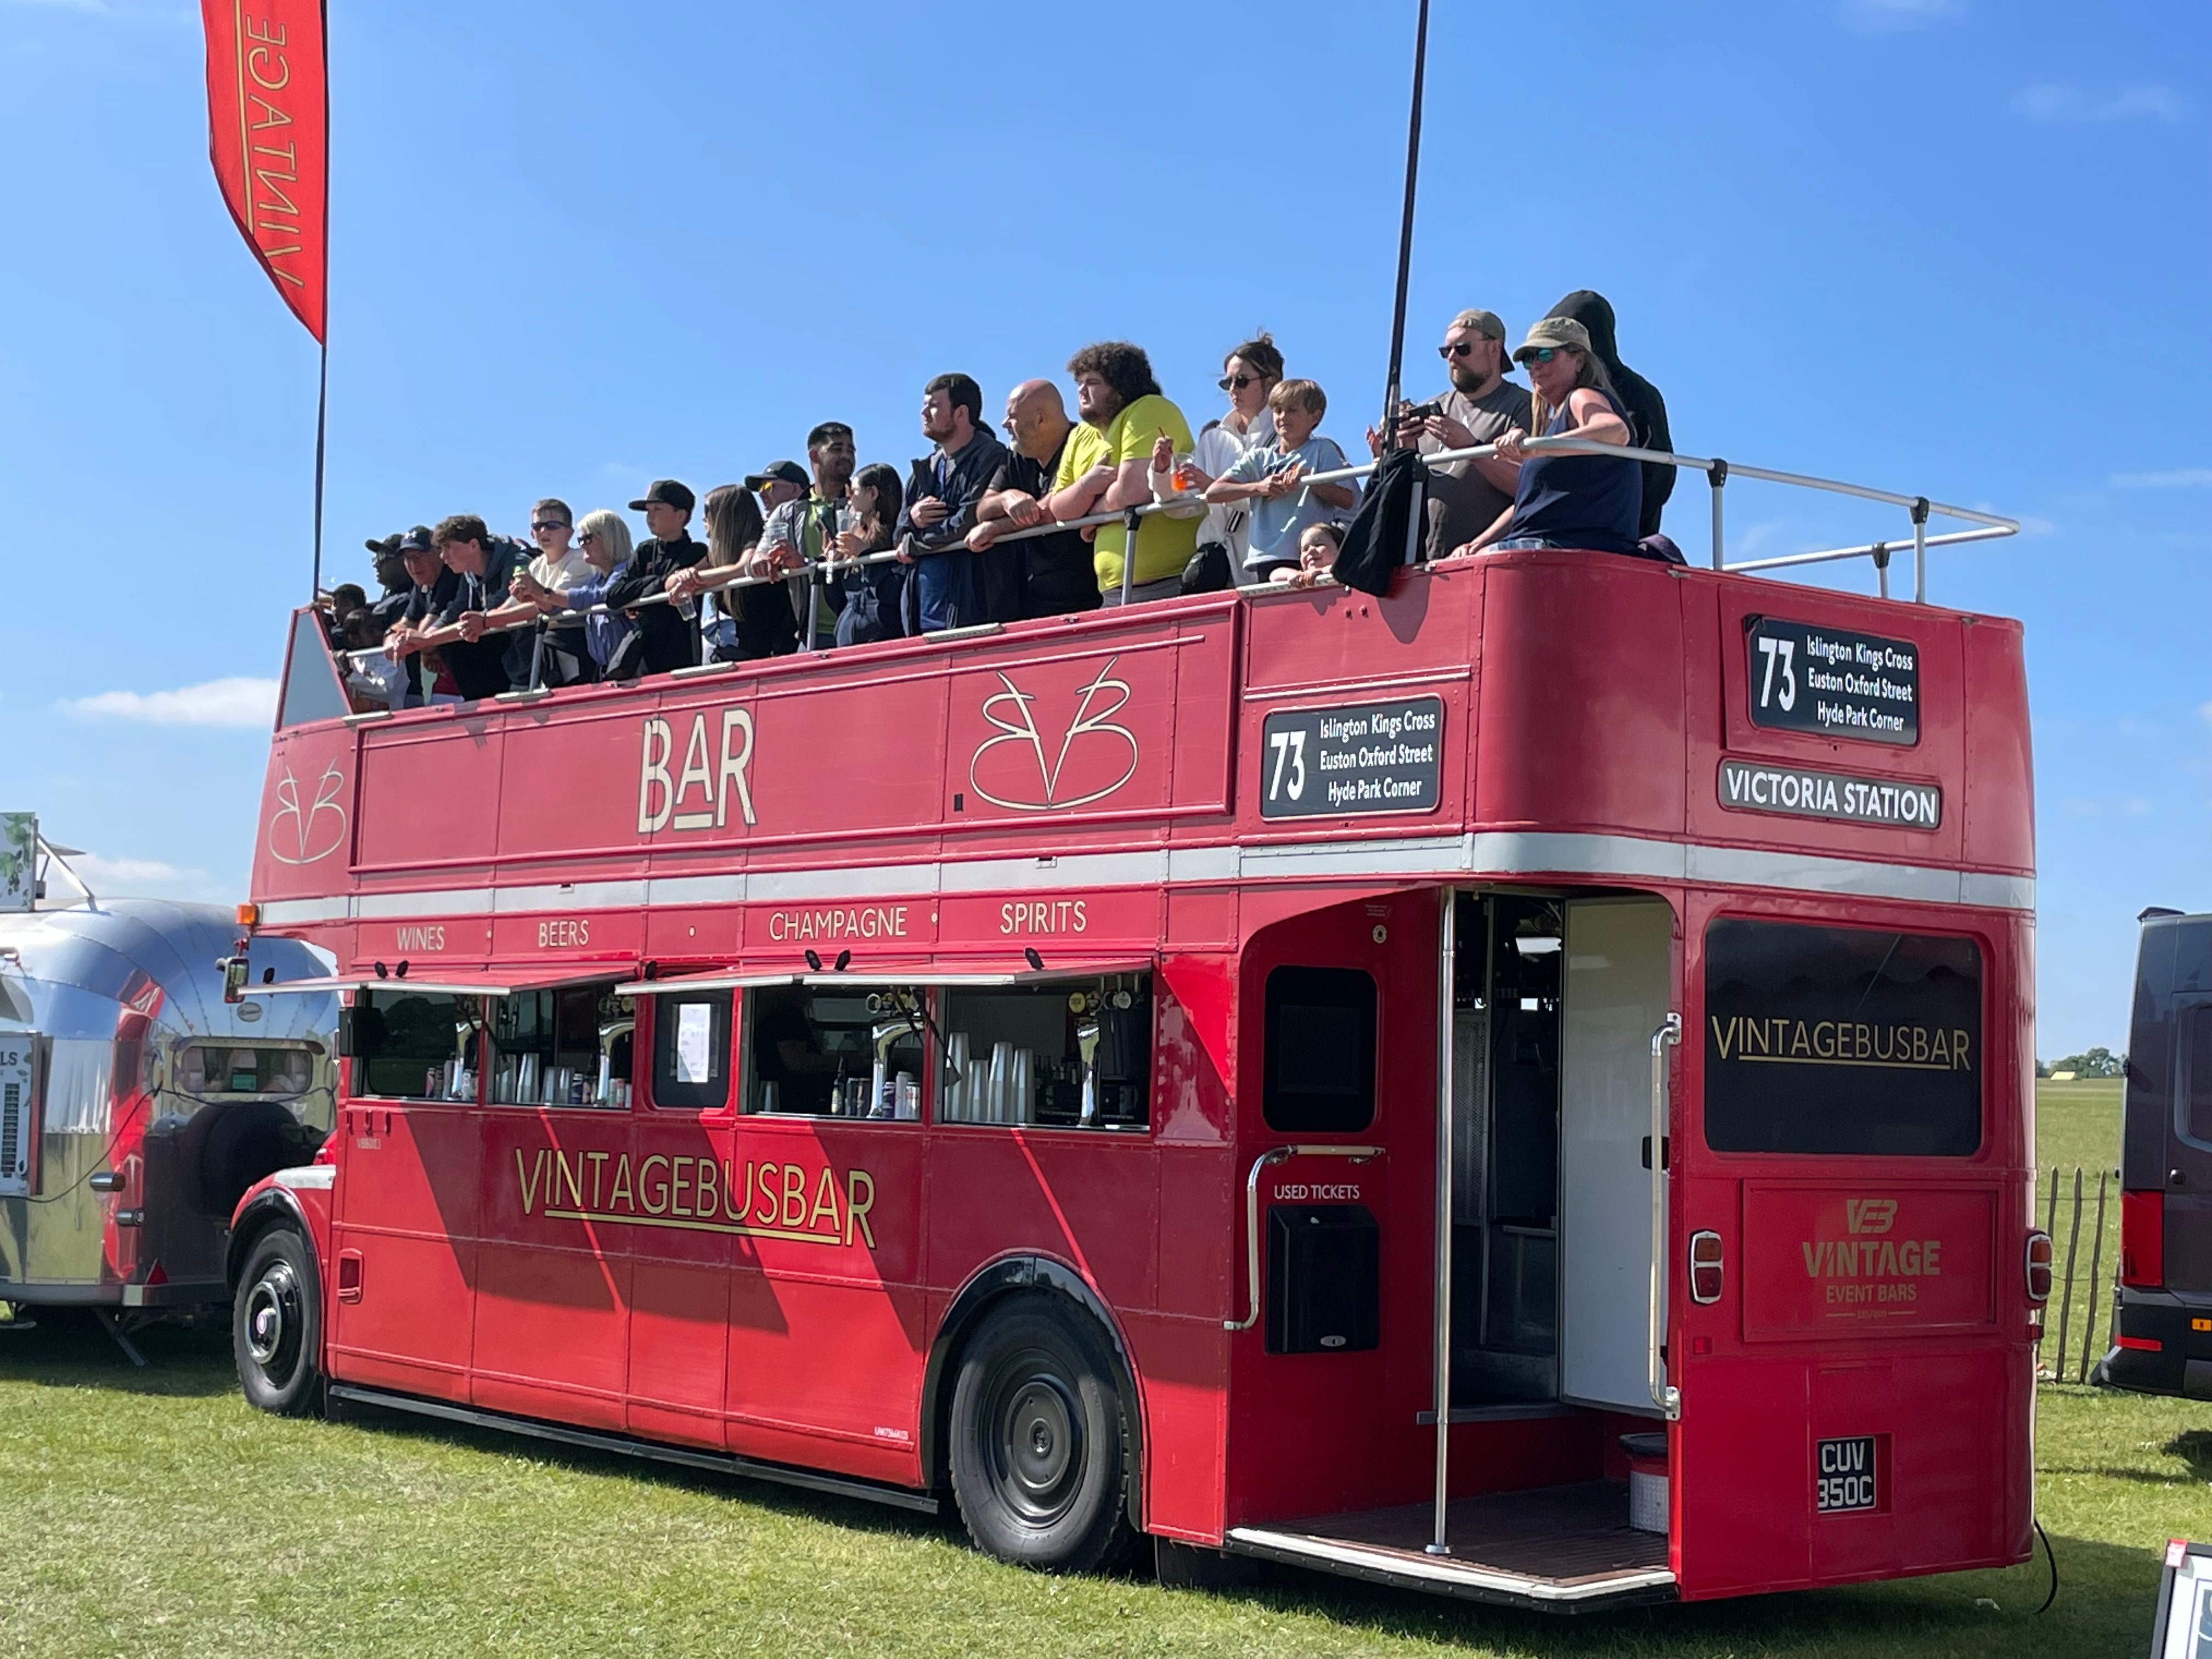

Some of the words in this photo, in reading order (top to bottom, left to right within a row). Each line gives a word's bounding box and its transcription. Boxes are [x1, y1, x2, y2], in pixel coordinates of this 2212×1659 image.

[1759, 636, 1796, 712] 73
[1807, 635, 1852, 664] Islington
[1855, 642, 1883, 672] Kings
[1885, 647, 1913, 671] Cross
[1808, 667, 1843, 692] Euston
[1845, 674, 1880, 699] Oxford
[1882, 678, 1912, 702] Street
[1817, 700, 1844, 727] Hyde
[1846, 704, 1867, 727] Park
[1870, 711, 1904, 732] Corner
[637, 707, 758, 834] BAR
[1269, 730, 1306, 801] 73
[1320, 718, 1367, 743] Islington
[1371, 713, 1402, 739] Kings
[1404, 710, 1435, 732] Cross
[1320, 749, 1356, 770] Euston
[1358, 745, 1396, 767] Oxford
[1398, 743, 1433, 764] Street
[1328, 781, 1356, 807] Hyde
[1358, 779, 1381, 799] Park
[1384, 777, 1421, 798] Corner
[1726, 768, 1838, 812] VICTORIA
[1843, 782, 1937, 824] STATION
[538, 919, 590, 948] BEERS
[769, 906, 909, 942] CHAMPAGNE
[1000, 900, 1087, 935] SPIRITS
[396, 926, 445, 952] WINES
[1711, 1015, 1972, 1071] VINTAGEBUSBAR
[515, 1147, 876, 1249] VINTAGEBUSBAR
[1274, 1184, 1308, 1200] USED
[1310, 1184, 1360, 1200] TICKETS
[1802, 1240, 1942, 1278] VINTAGE
[1826, 1284, 1875, 1304] EVENT
[1878, 1283, 1917, 1302] BARS
[1822, 1442, 1865, 1472] CUV
[1818, 1475, 1872, 1508] 350C
